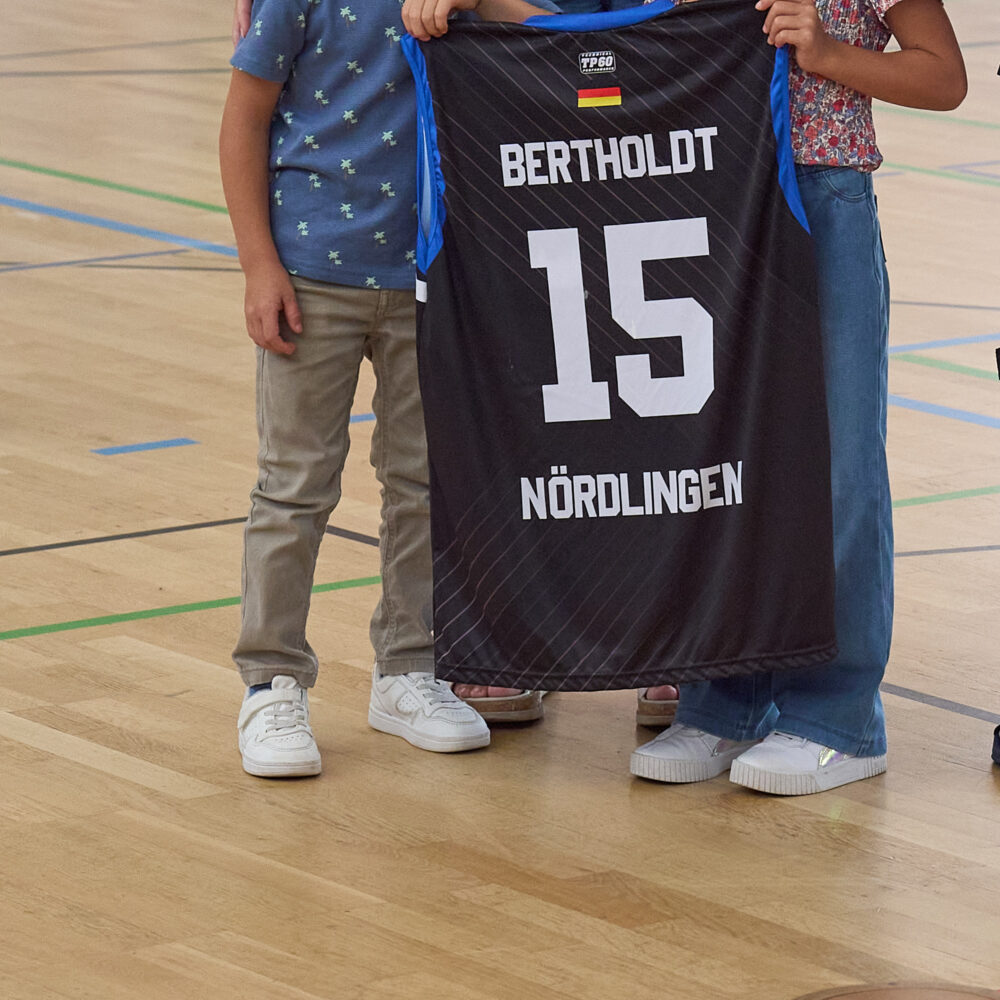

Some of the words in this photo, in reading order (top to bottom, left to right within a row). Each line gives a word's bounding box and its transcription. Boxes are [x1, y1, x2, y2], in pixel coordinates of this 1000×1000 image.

[581, 56, 613, 68] TP60
[500, 127, 718, 187] BERTHOLDT
[528, 217, 715, 423] 15
[521, 460, 743, 520] NÖRDLINGEN
